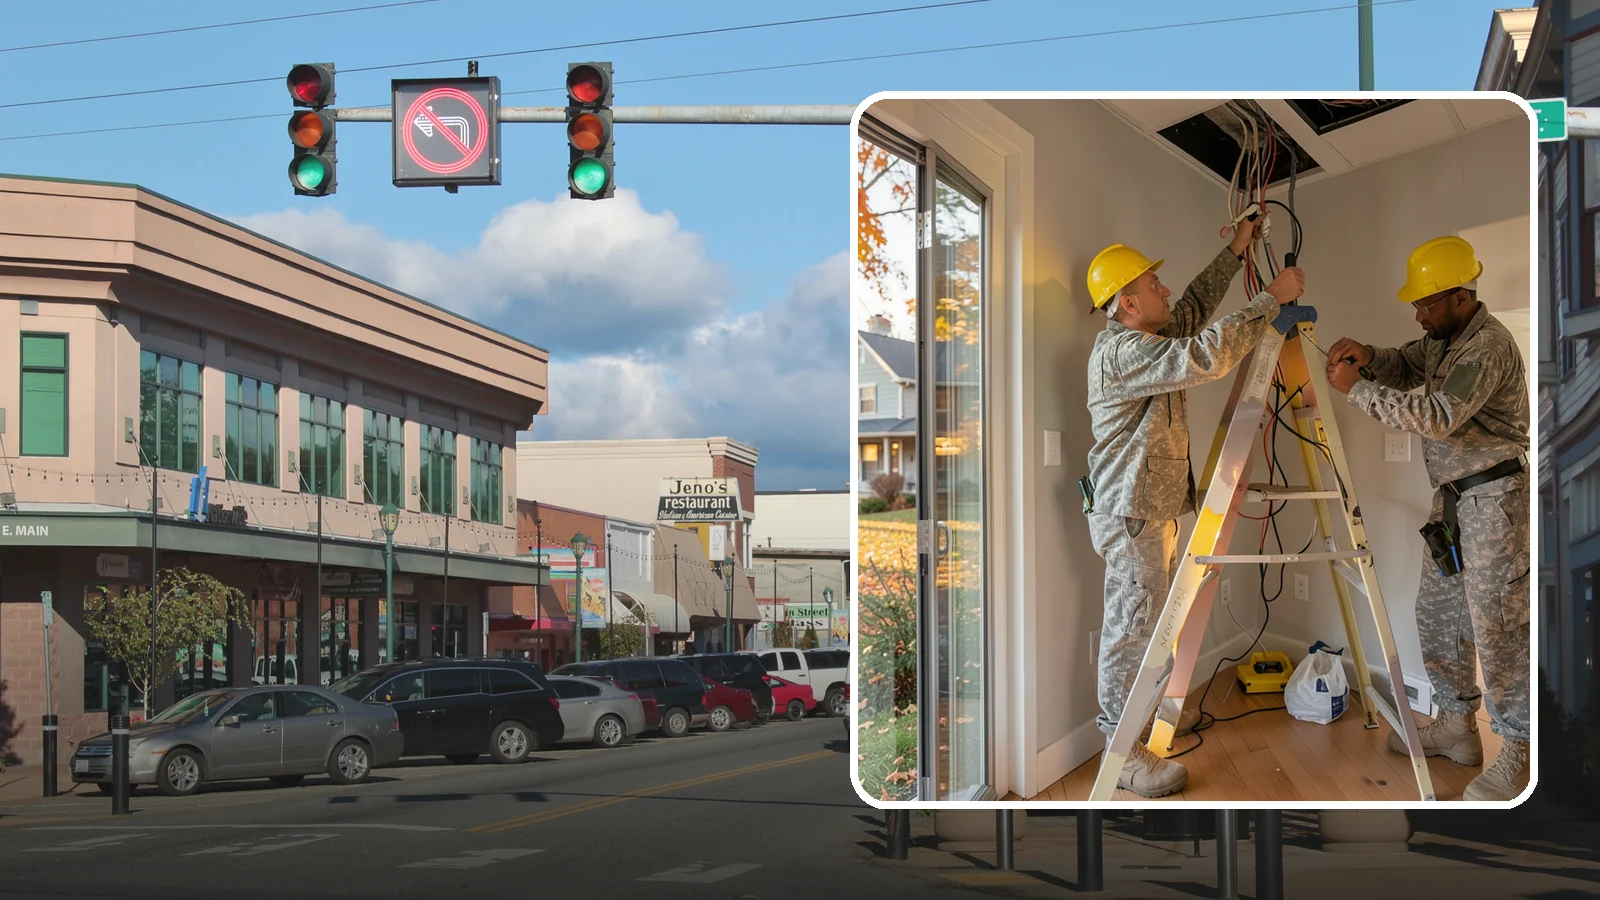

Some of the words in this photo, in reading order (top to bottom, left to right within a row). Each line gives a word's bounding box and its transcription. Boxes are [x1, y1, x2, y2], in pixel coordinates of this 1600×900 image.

[670, 480, 727, 495] Jeno's
[665, 497, 731, 509] restaurant
[686, 510, 714, 519] American
[715, 510, 737, 519] Cuisine
[2, 525, 13, 536] E.
[15, 525, 49, 536] MAIN
[797, 607, 828, 616] Street
